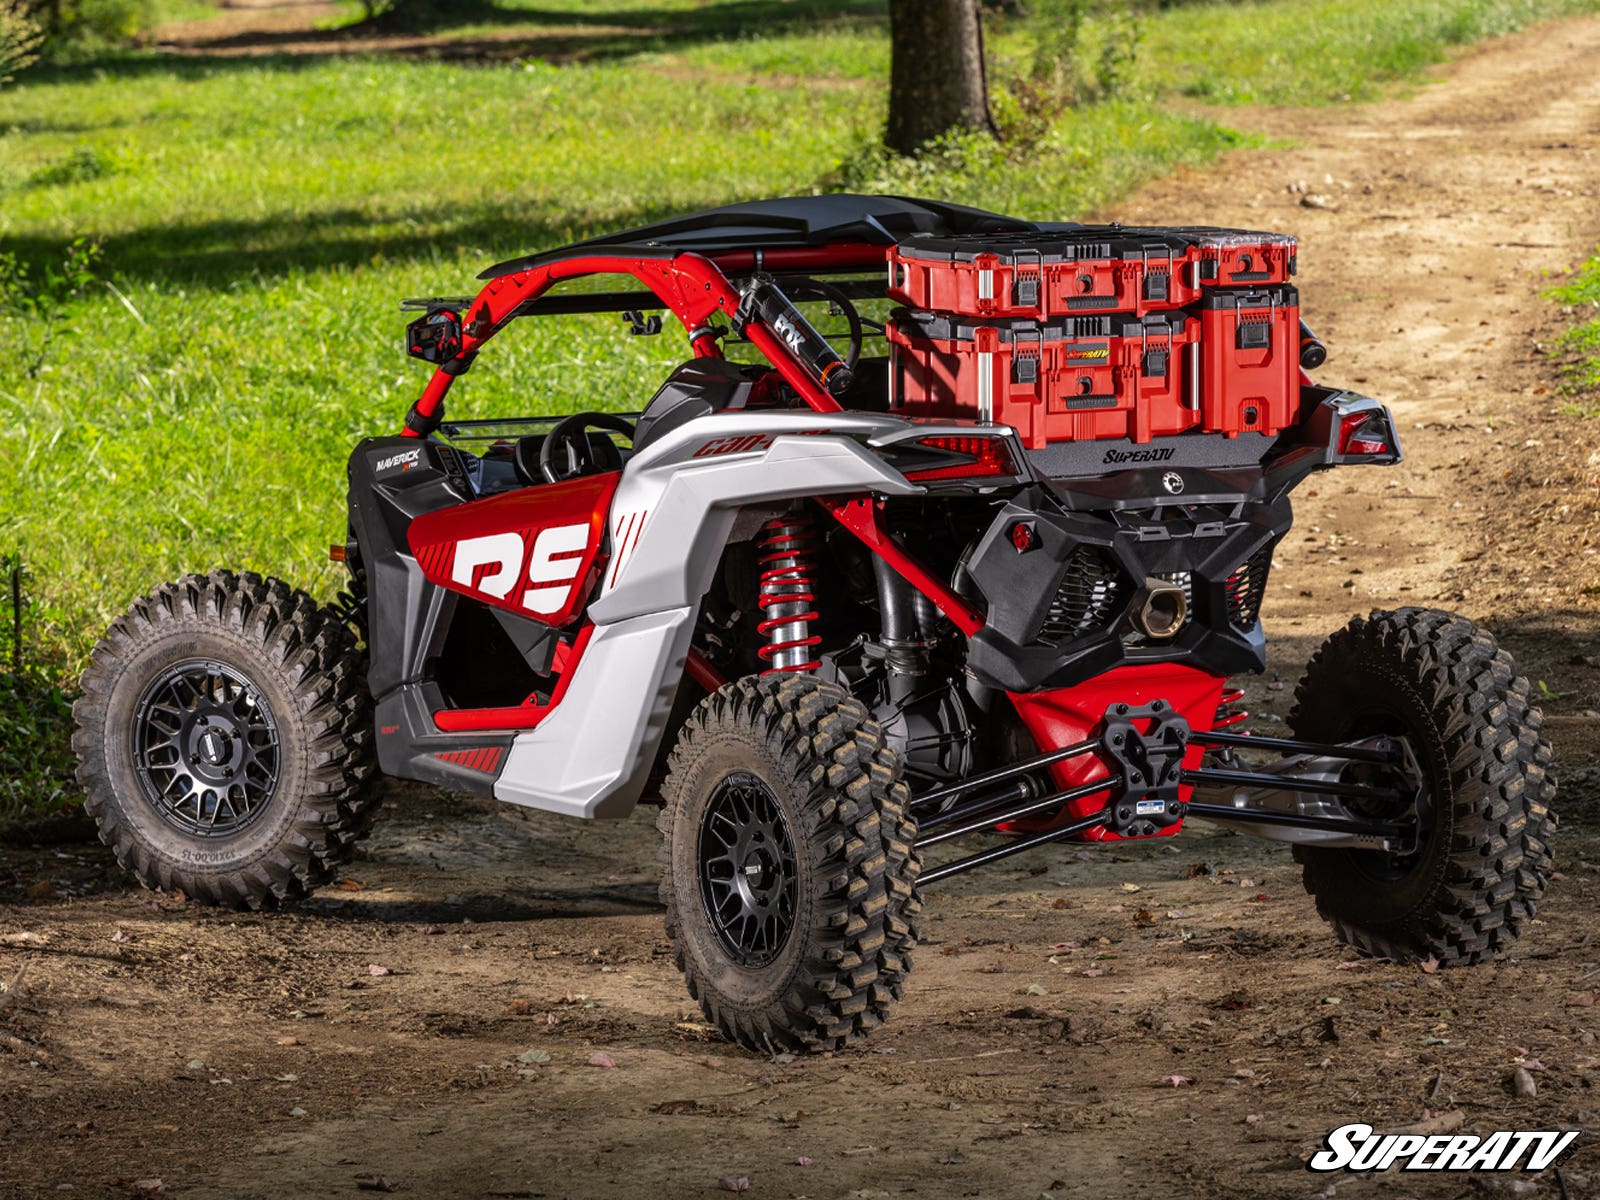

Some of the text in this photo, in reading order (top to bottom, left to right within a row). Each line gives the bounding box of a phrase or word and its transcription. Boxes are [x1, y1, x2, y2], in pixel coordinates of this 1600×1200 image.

[774, 313, 806, 355] FOX
[376, 448, 421, 472] MAVERICK
[452, 523, 590, 614] RS
